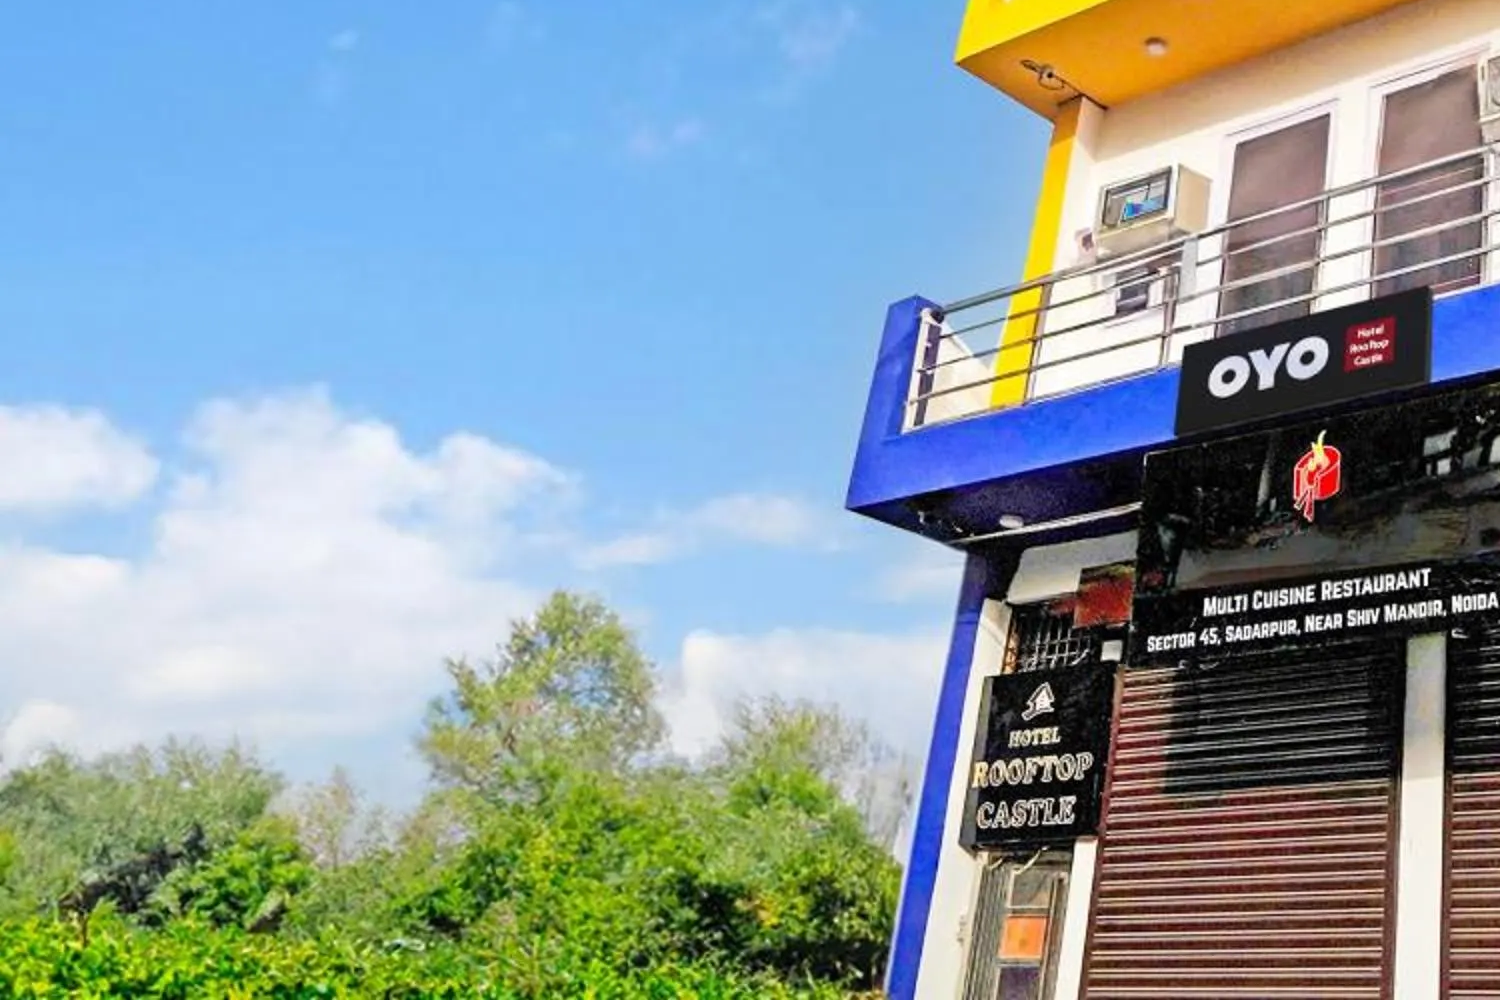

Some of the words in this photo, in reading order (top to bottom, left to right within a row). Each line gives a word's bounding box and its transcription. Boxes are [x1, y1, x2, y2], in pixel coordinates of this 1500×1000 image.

[1207, 336, 1329, 398] OYO
[1203, 594, 1248, 617] MULTI
[1252, 584, 1316, 611] CUISINE
[1321, 567, 1432, 601] RESTAURANT
[1147, 632, 1196, 653] SECTOR
[1200, 627, 1221, 646] 45,
[1225, 619, 1301, 643] SADARPUR,
[1304, 613, 1343, 633] NEAR
[1347, 607, 1380, 627] SHIV
[1384, 599, 1447, 623] MANDIR,
[1452, 592, 1499, 614] NOIDA
[1008, 726, 1061, 749] HOTEL
[971, 752, 1094, 788] ROOFTOP
[976, 794, 1077, 829] CASTLE
